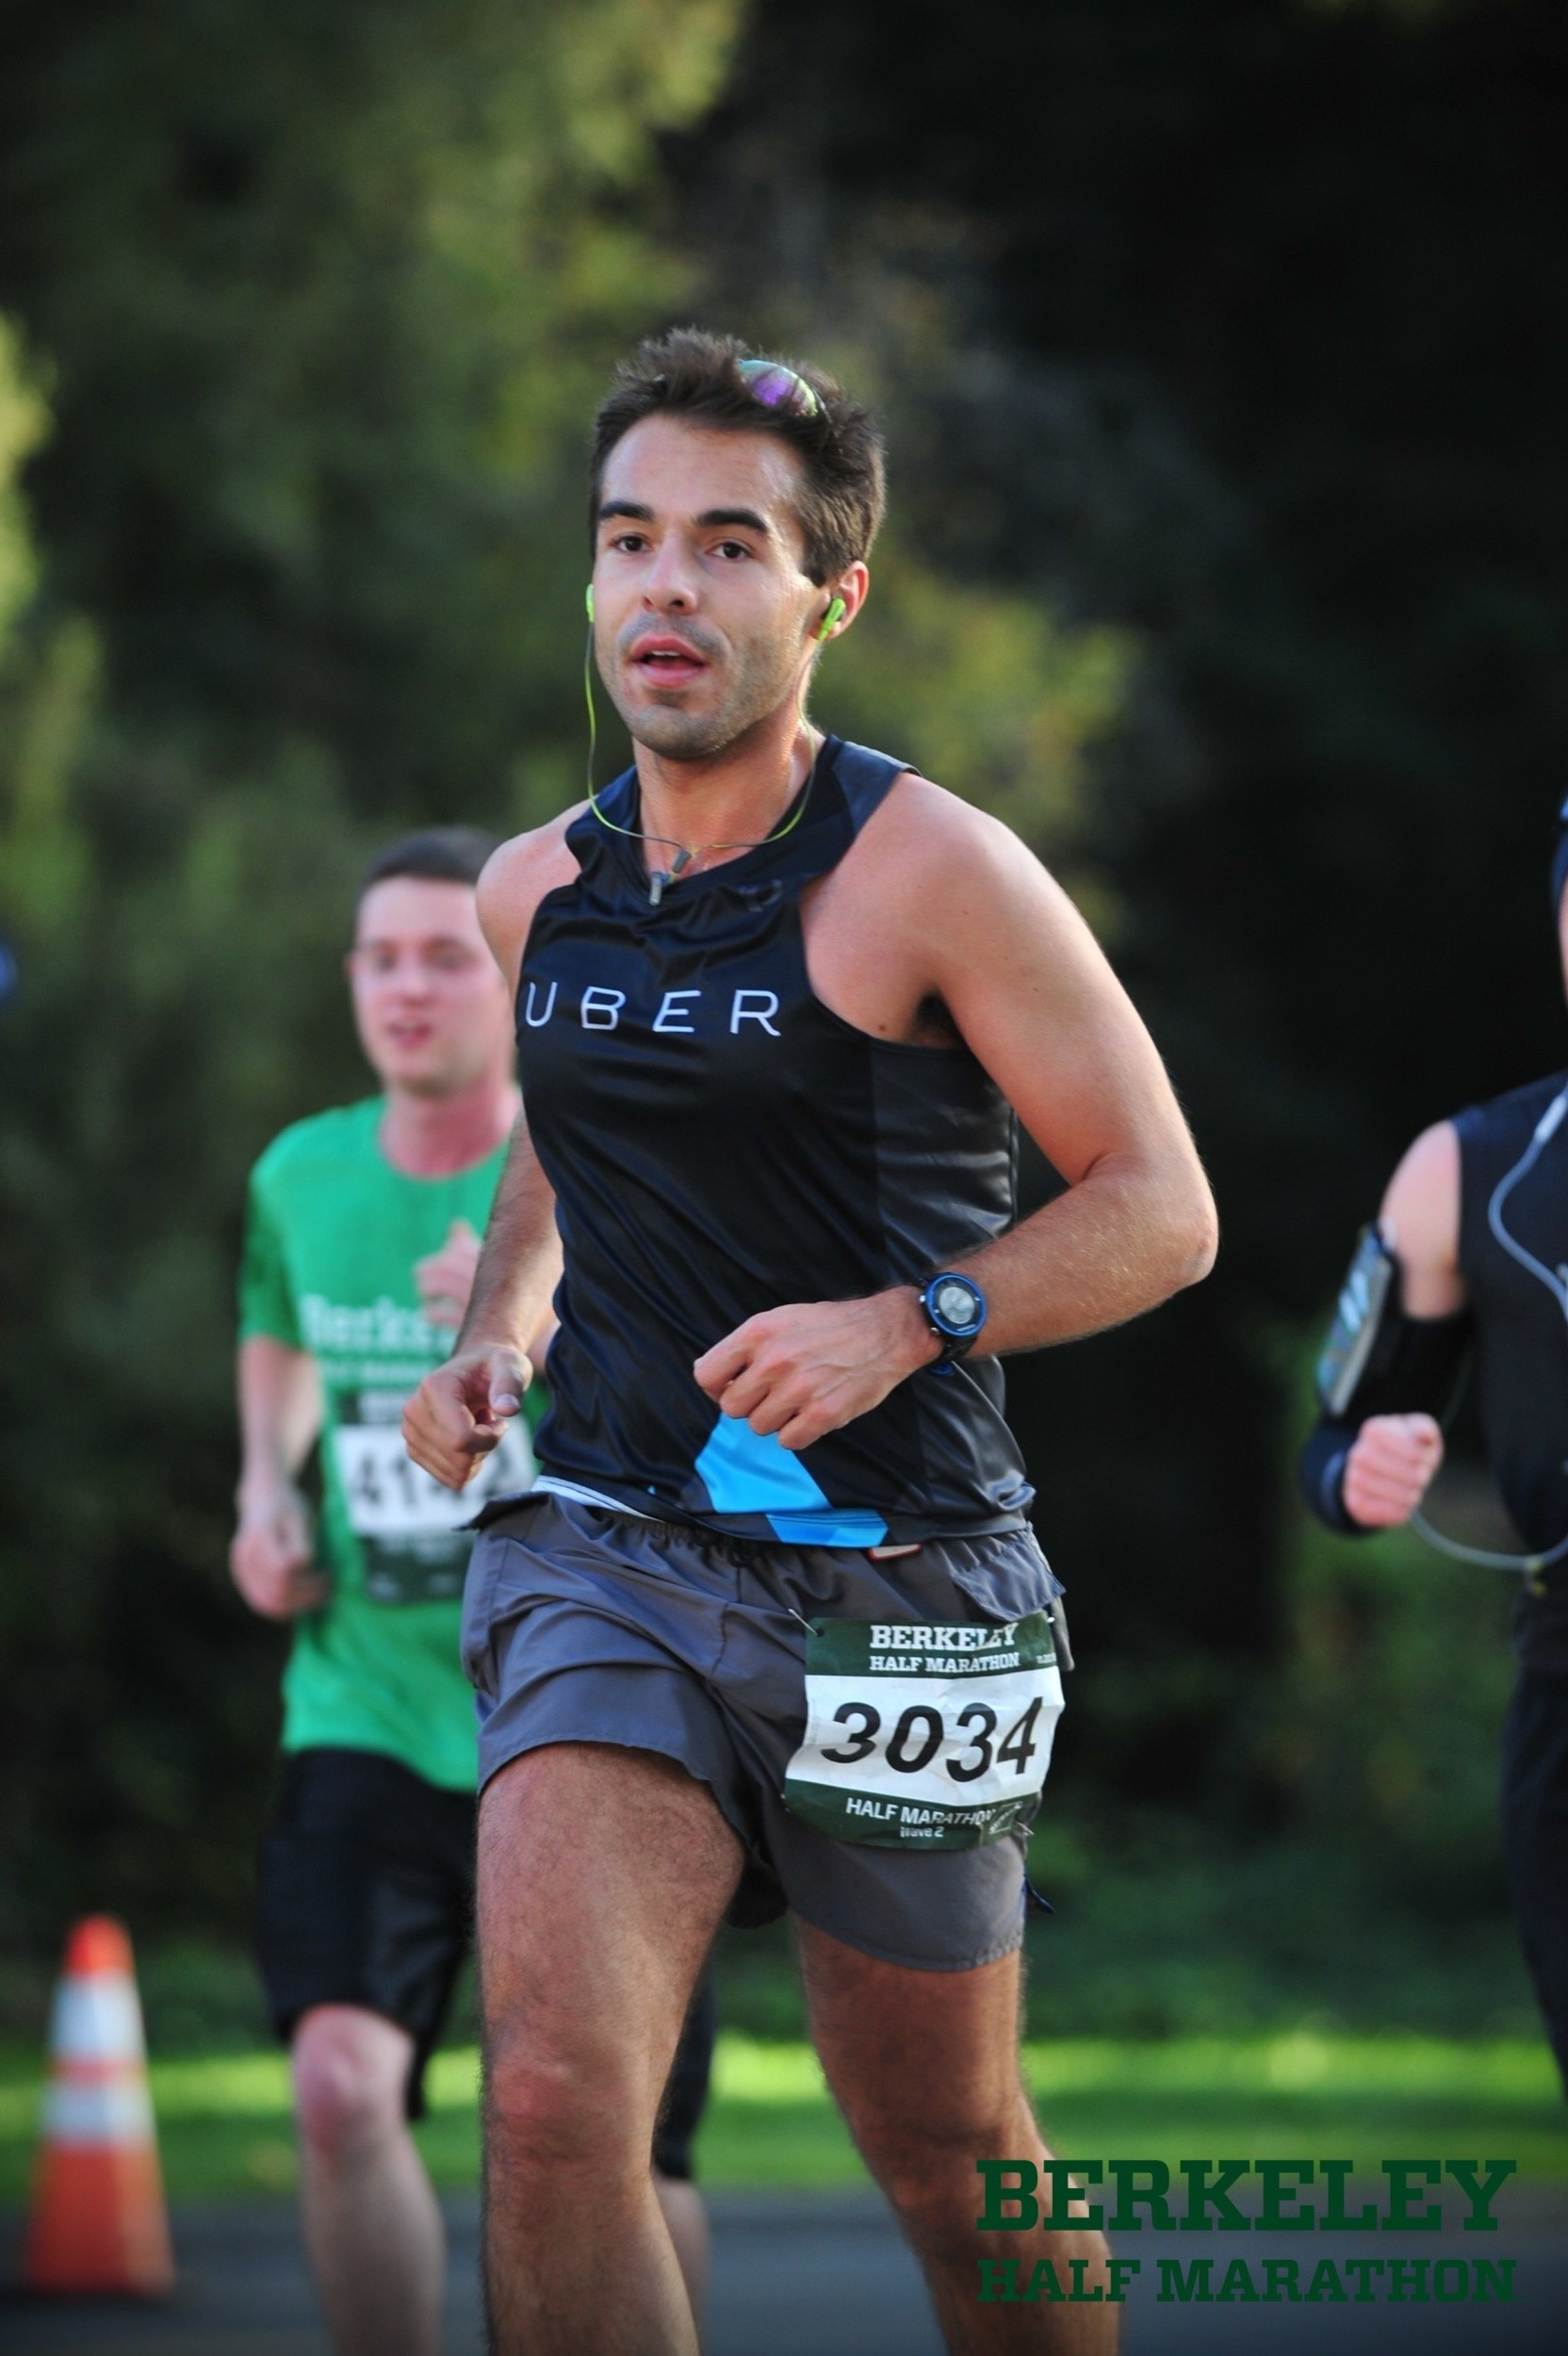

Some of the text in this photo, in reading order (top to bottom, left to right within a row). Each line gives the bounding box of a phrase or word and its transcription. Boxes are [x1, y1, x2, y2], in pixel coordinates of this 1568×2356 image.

[525, 981, 781, 1037] UBER
[869, 1622, 1019, 1650] BERKELEY
[869, 1655, 923, 1672] HALF
[924, 1651, 1021, 1673] MARATHON
[820, 1695, 1043, 1783] 3034
[845, 1796, 899, 1821] HALF
[935, 1825, 945, 1839] 2
